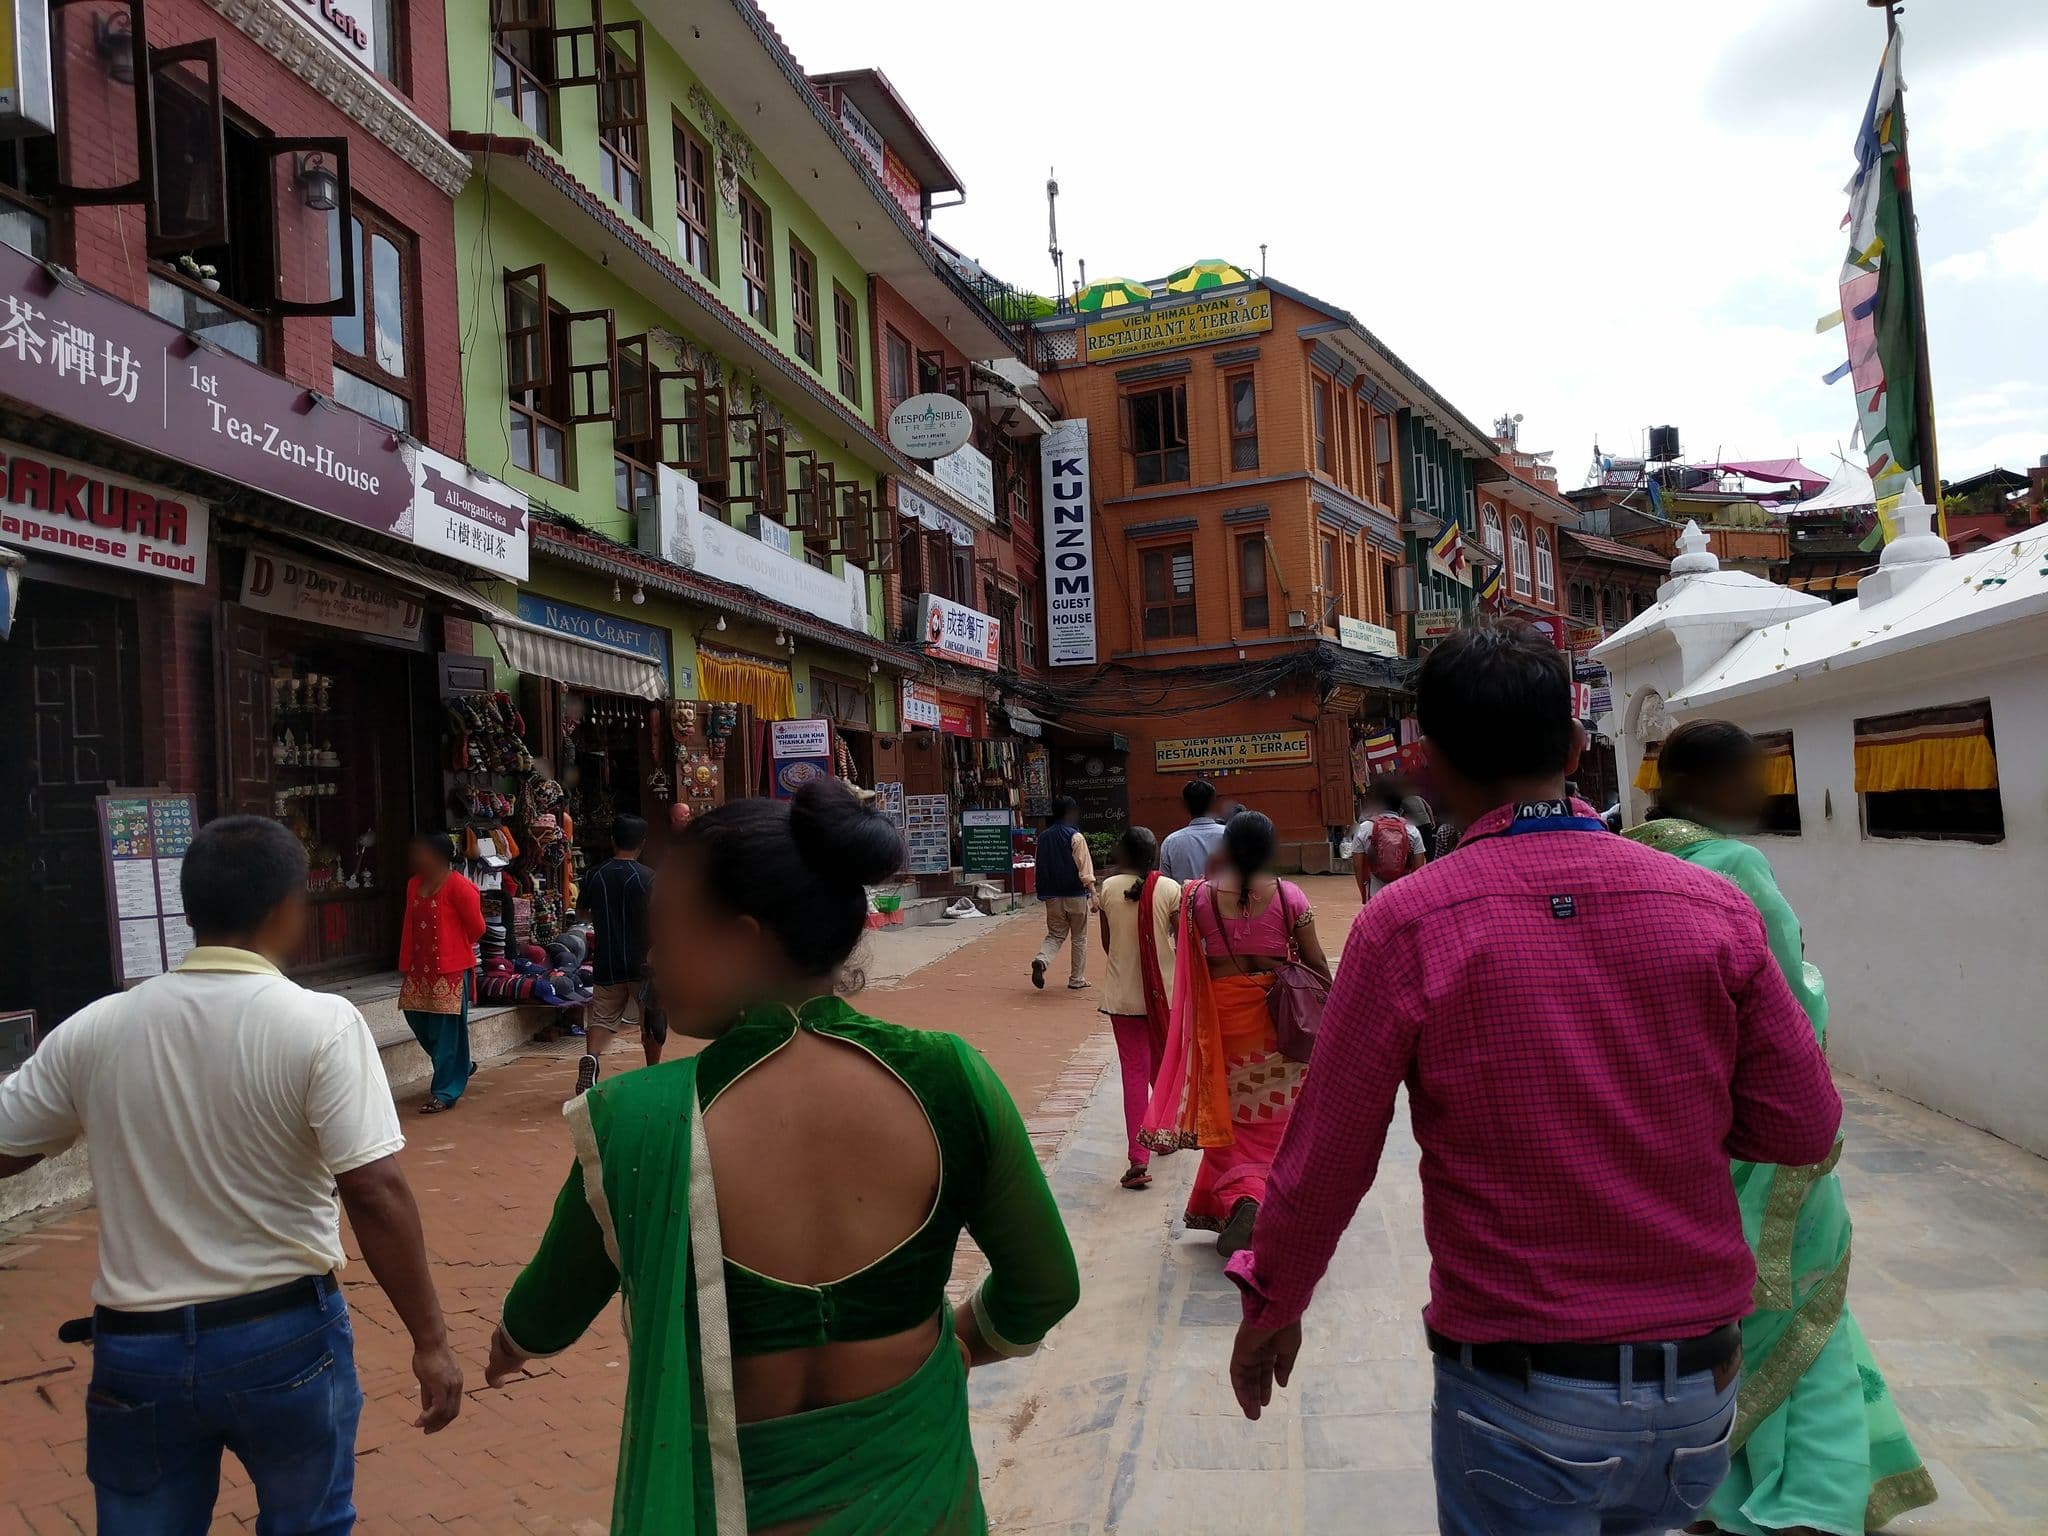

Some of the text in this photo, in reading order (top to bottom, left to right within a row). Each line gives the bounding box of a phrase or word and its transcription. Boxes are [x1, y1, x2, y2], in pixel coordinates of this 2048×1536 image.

[1088, 304, 1269, 351] RESTAURANT & TERRACE
[1122, 300, 1229, 328] VIEW HIMALAYAN
[0, 295, 141, 403] 茶禪坊
[190, 366, 218, 397] 1st
[207, 399, 380, 496] Tea-Zen-House
[0, 452, 188, 546] AKURA
[445, 489, 507, 528] All-organic-tea
[1052, 457, 1090, 595] KUNZOM
[138, 543, 195, 574] Food
[1052, 597, 1091, 609] GUEST
[545, 606, 590, 636] NAYO
[594, 617, 642, 648] CRAFT
[947, 607, 985, 644] 成都餐厅
[1052, 613, 1092, 625] HOUSE
[1575, 629, 1598, 641] DHL
[1157, 740, 1306, 760] RESTAURANT & TERRACE
[1182, 734, 1282, 747] VIEW HIMALAYAN
[1200, 758, 1246, 767] 3rd FLOOR
